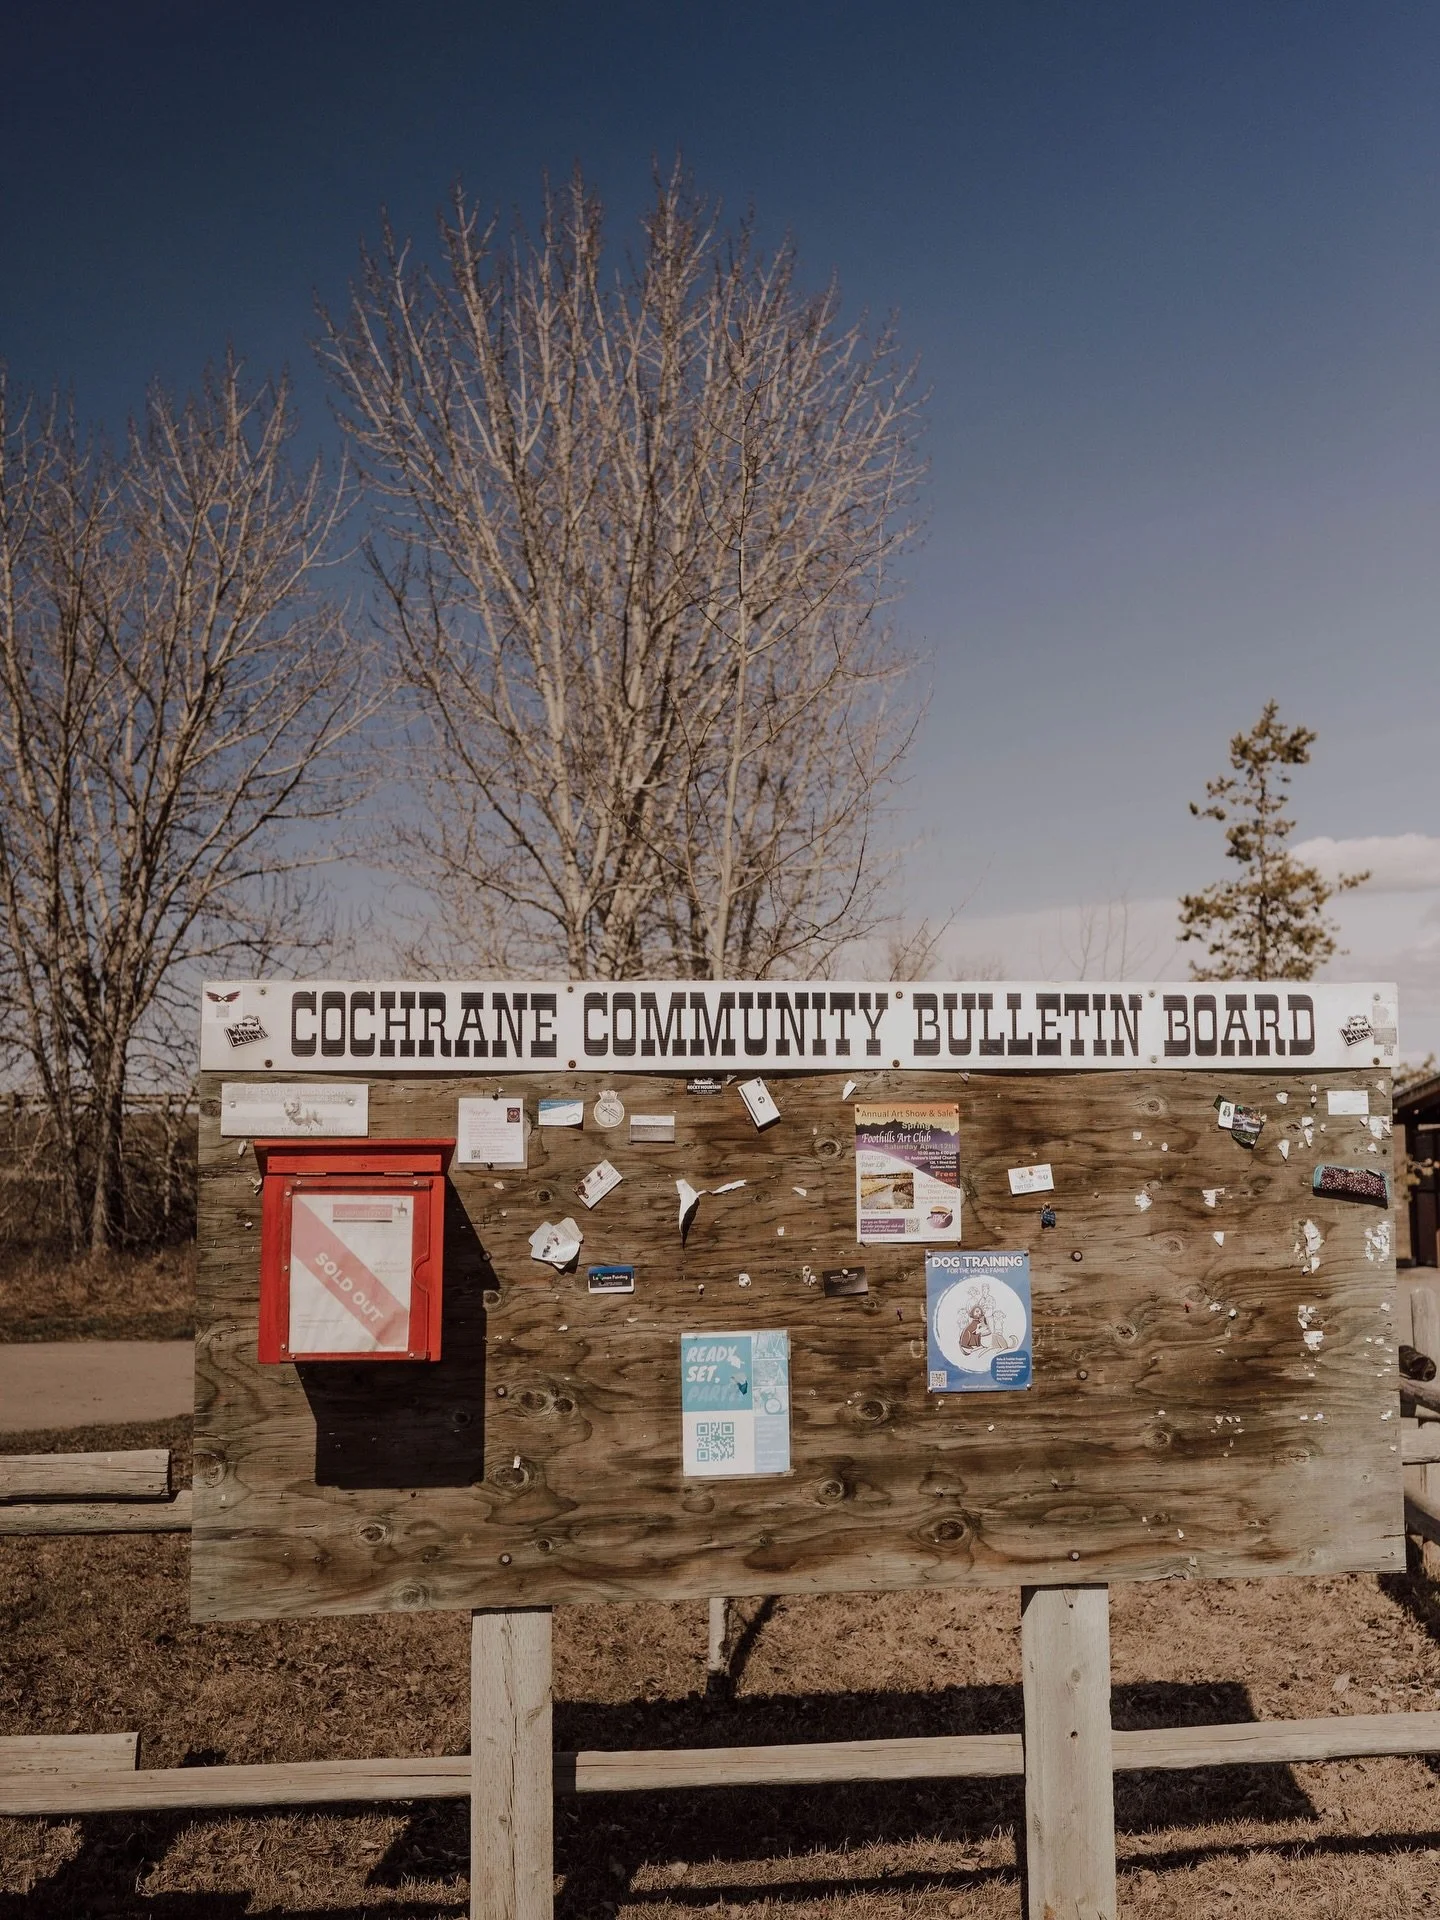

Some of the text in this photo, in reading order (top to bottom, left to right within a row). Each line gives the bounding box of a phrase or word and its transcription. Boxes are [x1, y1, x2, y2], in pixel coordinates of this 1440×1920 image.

[291, 991, 557, 1057] COCHRANE
[584, 992, 888, 1056] COMMUNITY
[912, 993, 1142, 1056] BULLETIN
[1163, 994, 1315, 1056] BOARD
[861, 1110, 889, 1118] Annual
[891, 1110, 903, 1118] Art
[906, 1110, 926, 1118] Show
[938, 1109, 953, 1118] Sale
[901, 1122, 931, 1131] Spring
[861, 1130, 932, 1143] Foothills Art Club
[920, 1143, 938, 1151] April
[932, 1256, 1023, 1268] DOG TRAINING
[315, 1252, 353, 1292] SOLD
[352, 1292, 384, 1323] OUT
